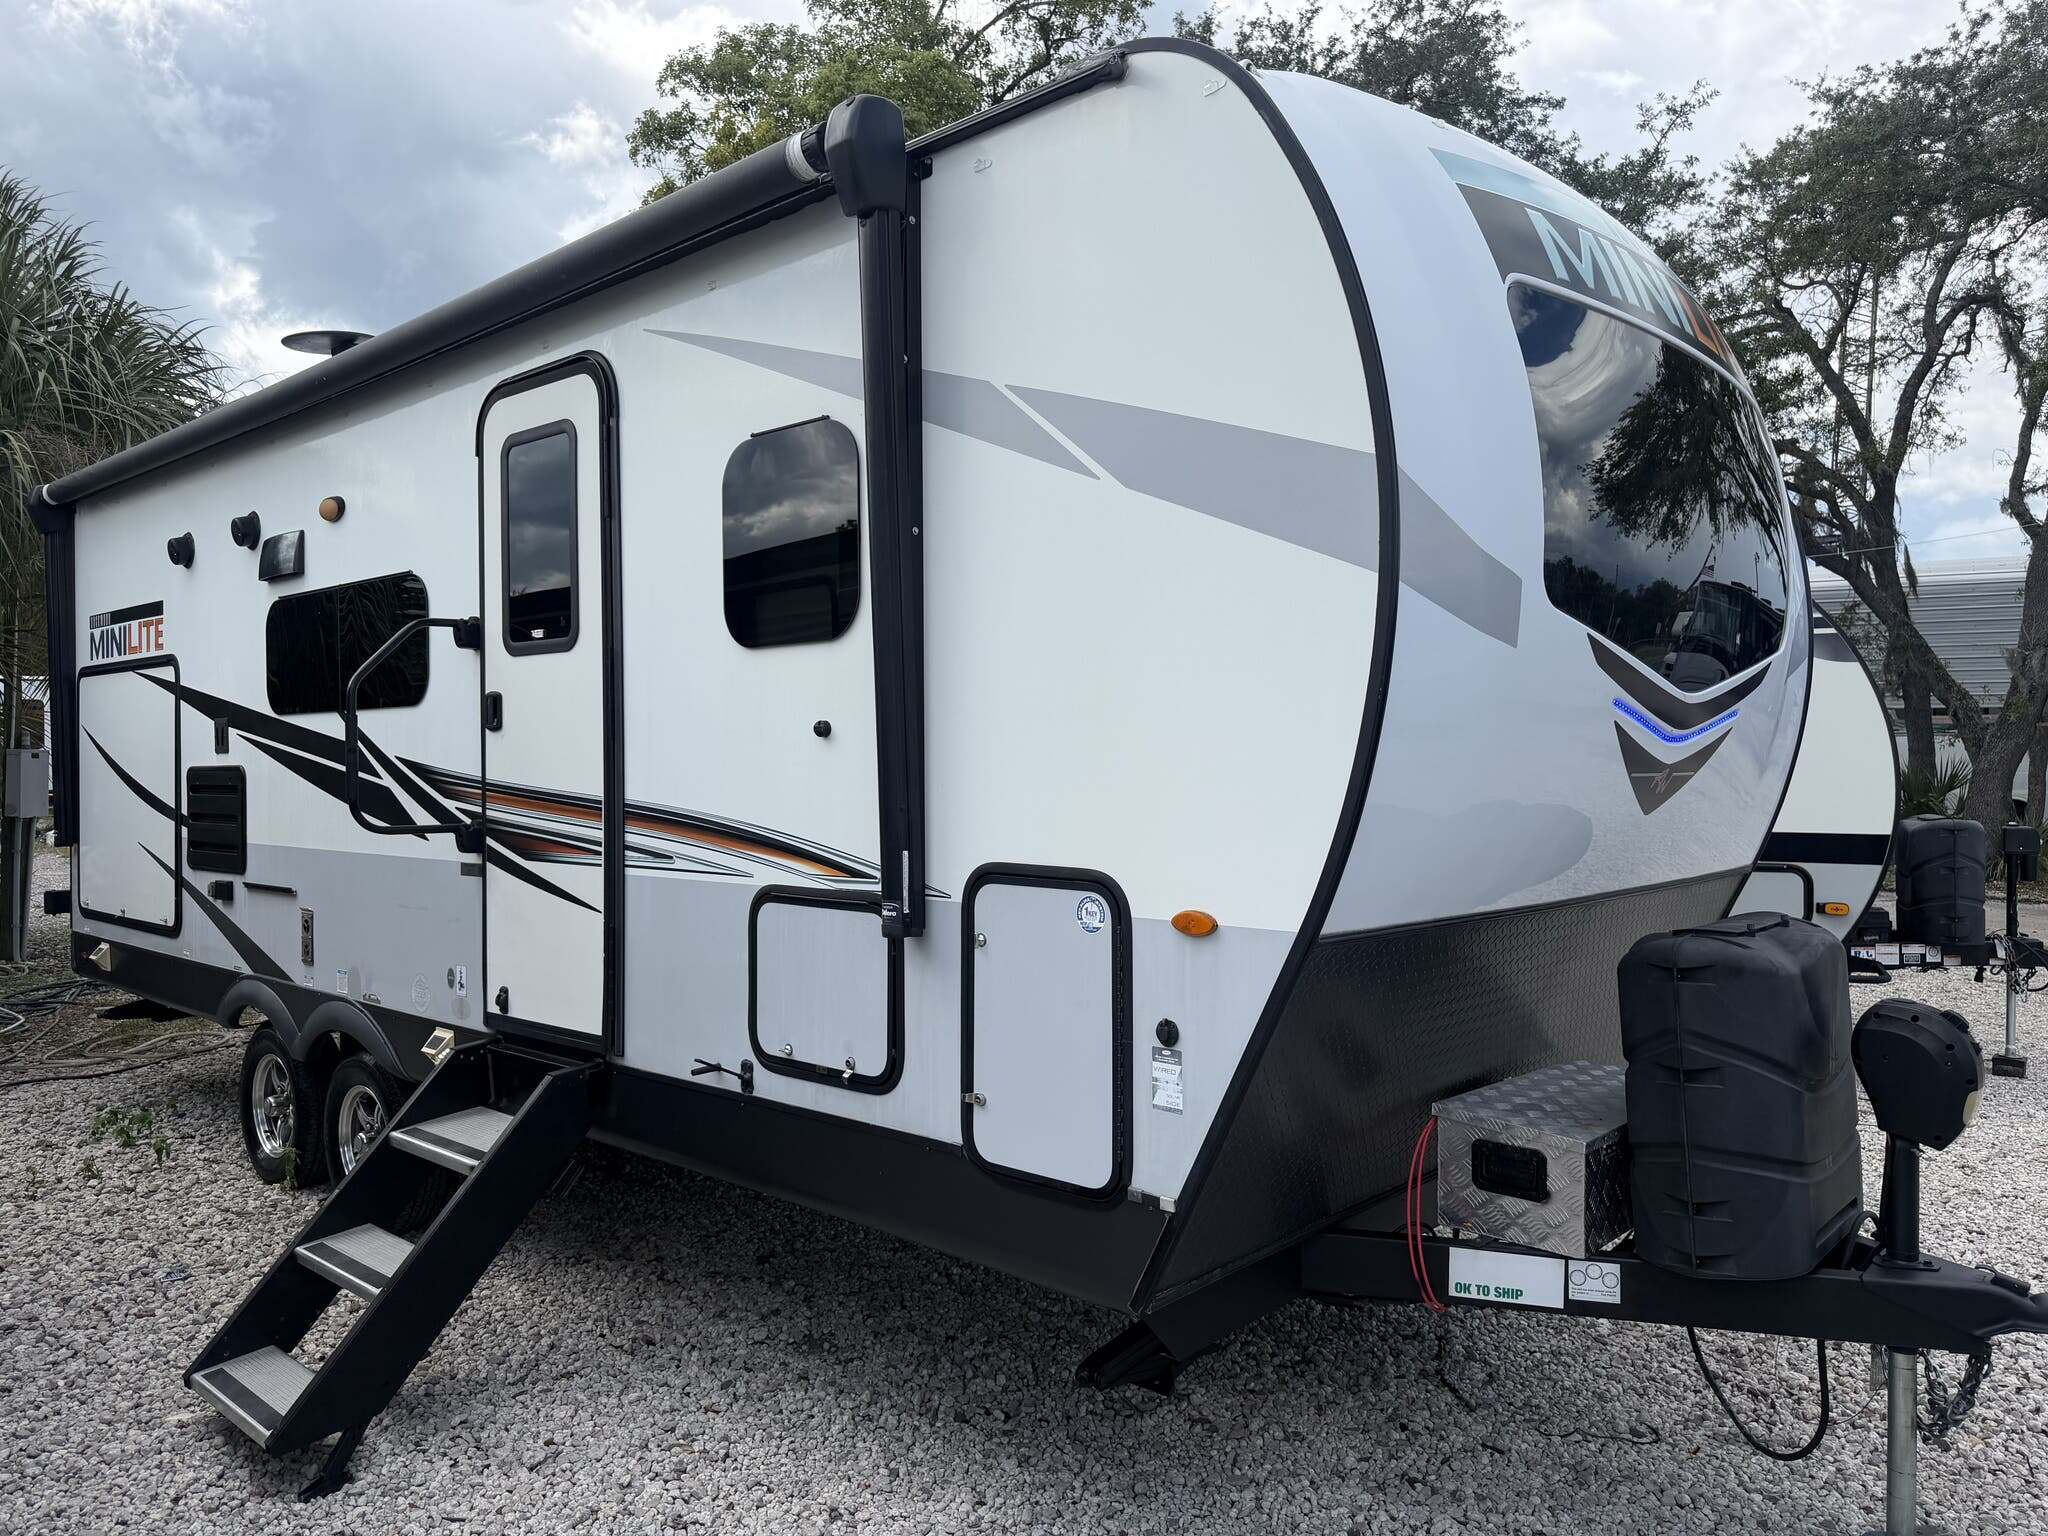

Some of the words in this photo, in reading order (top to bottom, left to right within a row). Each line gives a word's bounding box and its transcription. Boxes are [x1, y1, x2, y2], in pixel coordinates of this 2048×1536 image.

[1454, 1281, 1472, 1295] OK
[1475, 1284, 1490, 1297] TO
[1493, 1286, 1524, 1300] SHIP
